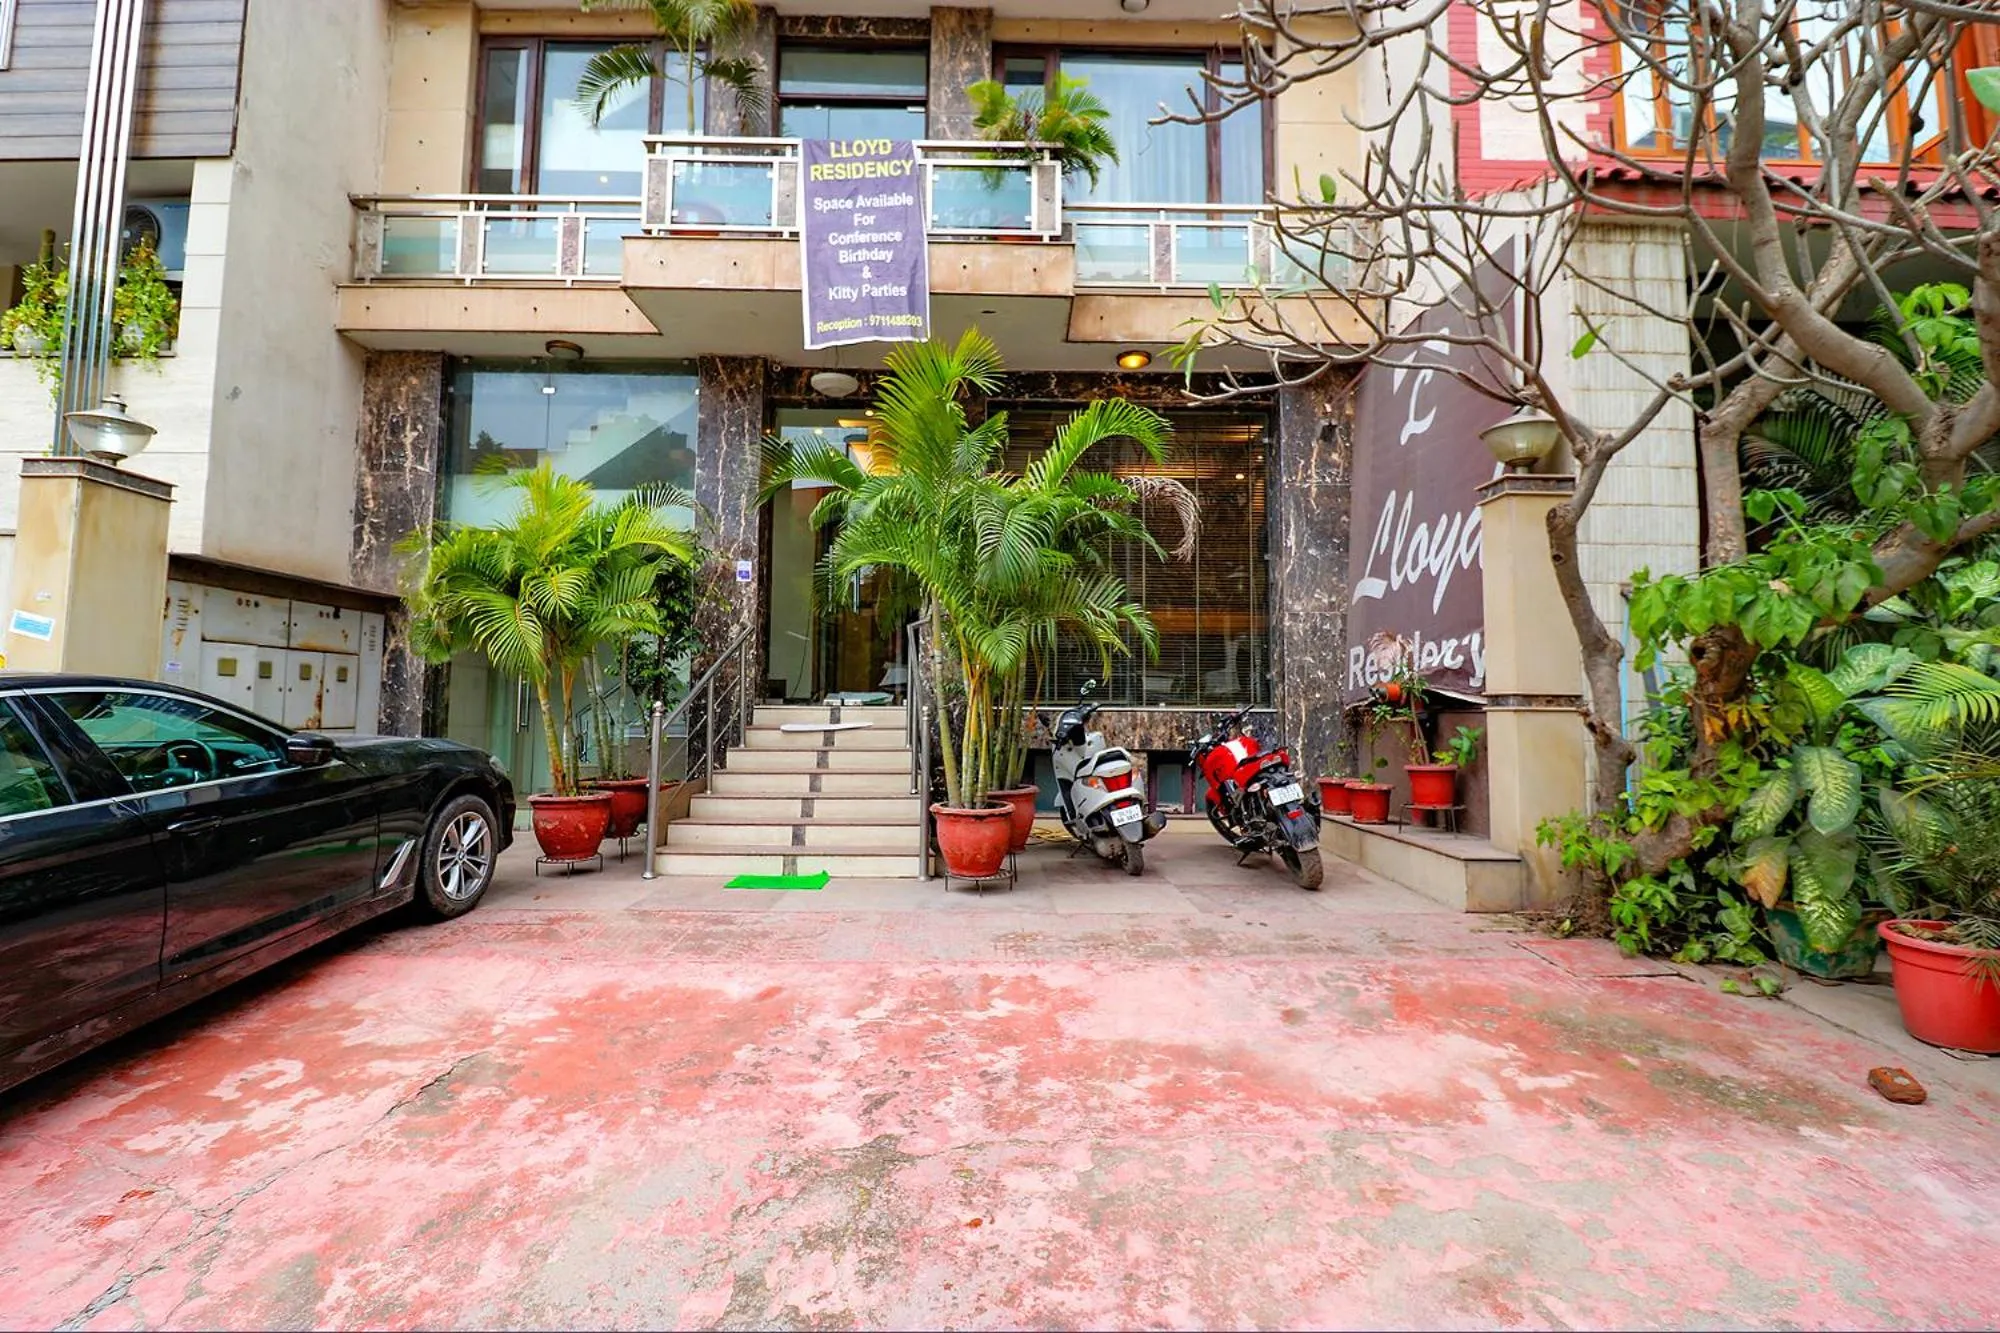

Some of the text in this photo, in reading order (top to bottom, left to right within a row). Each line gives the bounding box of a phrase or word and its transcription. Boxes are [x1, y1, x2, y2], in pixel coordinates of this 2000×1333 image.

[829, 139, 892, 158] LLOYD
[810, 159, 913, 181] RESIDENCY
[813, 192, 914, 214] Space Available
[853, 212, 877, 226] For
[828, 230, 904, 245] Conference
[838, 247, 894, 264] Birthday
[861, 265, 872, 279] &
[828, 282, 908, 302] Kitty Parties
[816, 317, 862, 333] Reception
